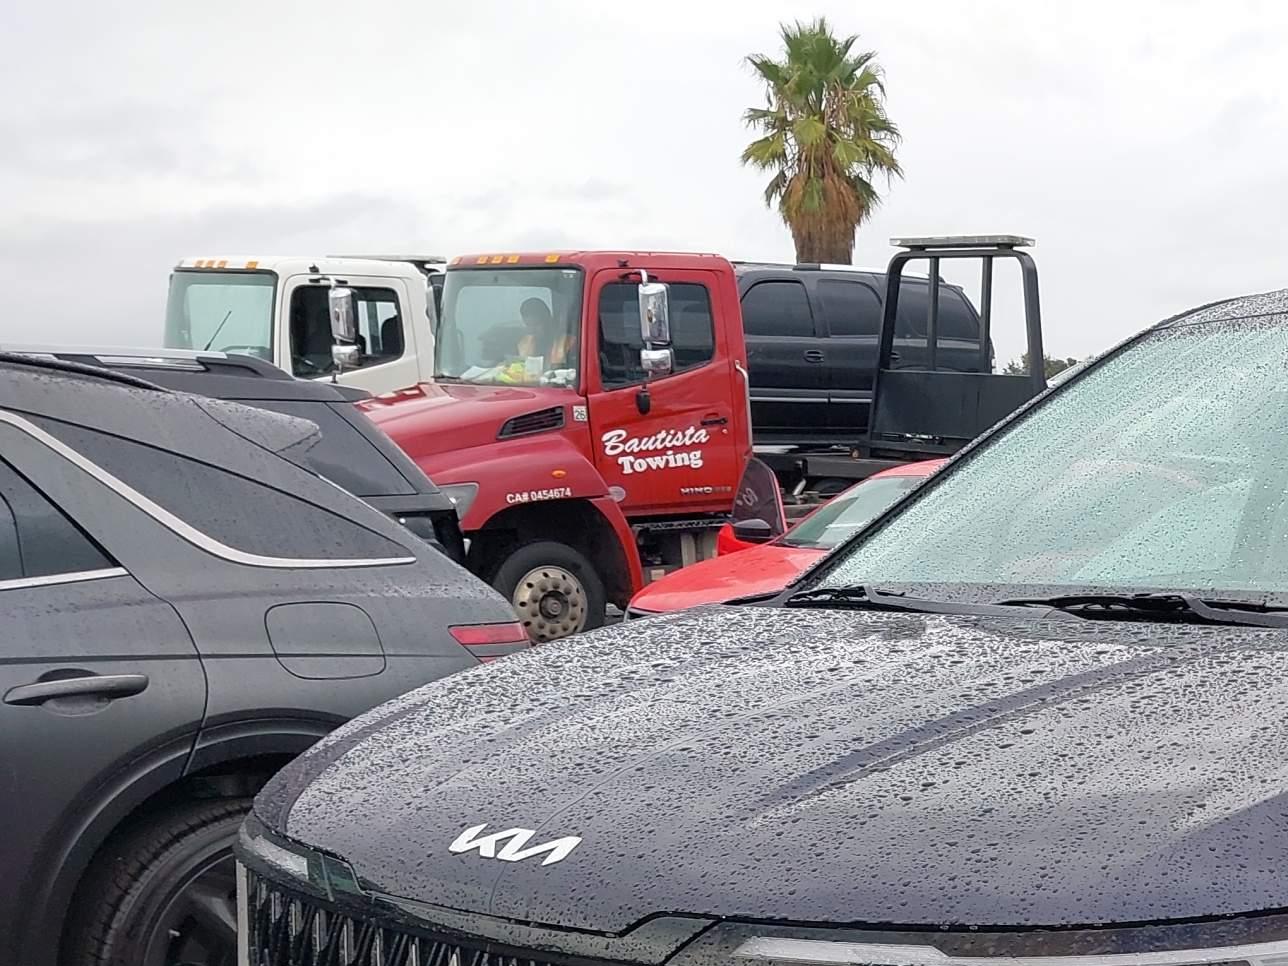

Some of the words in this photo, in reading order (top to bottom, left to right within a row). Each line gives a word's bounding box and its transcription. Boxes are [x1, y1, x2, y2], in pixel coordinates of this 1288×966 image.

[601, 426, 710, 455] Bautista
[617, 450, 703, 474] Towing
[506, 492, 529, 504] CA#
[530, 487, 572, 501] 0454674
